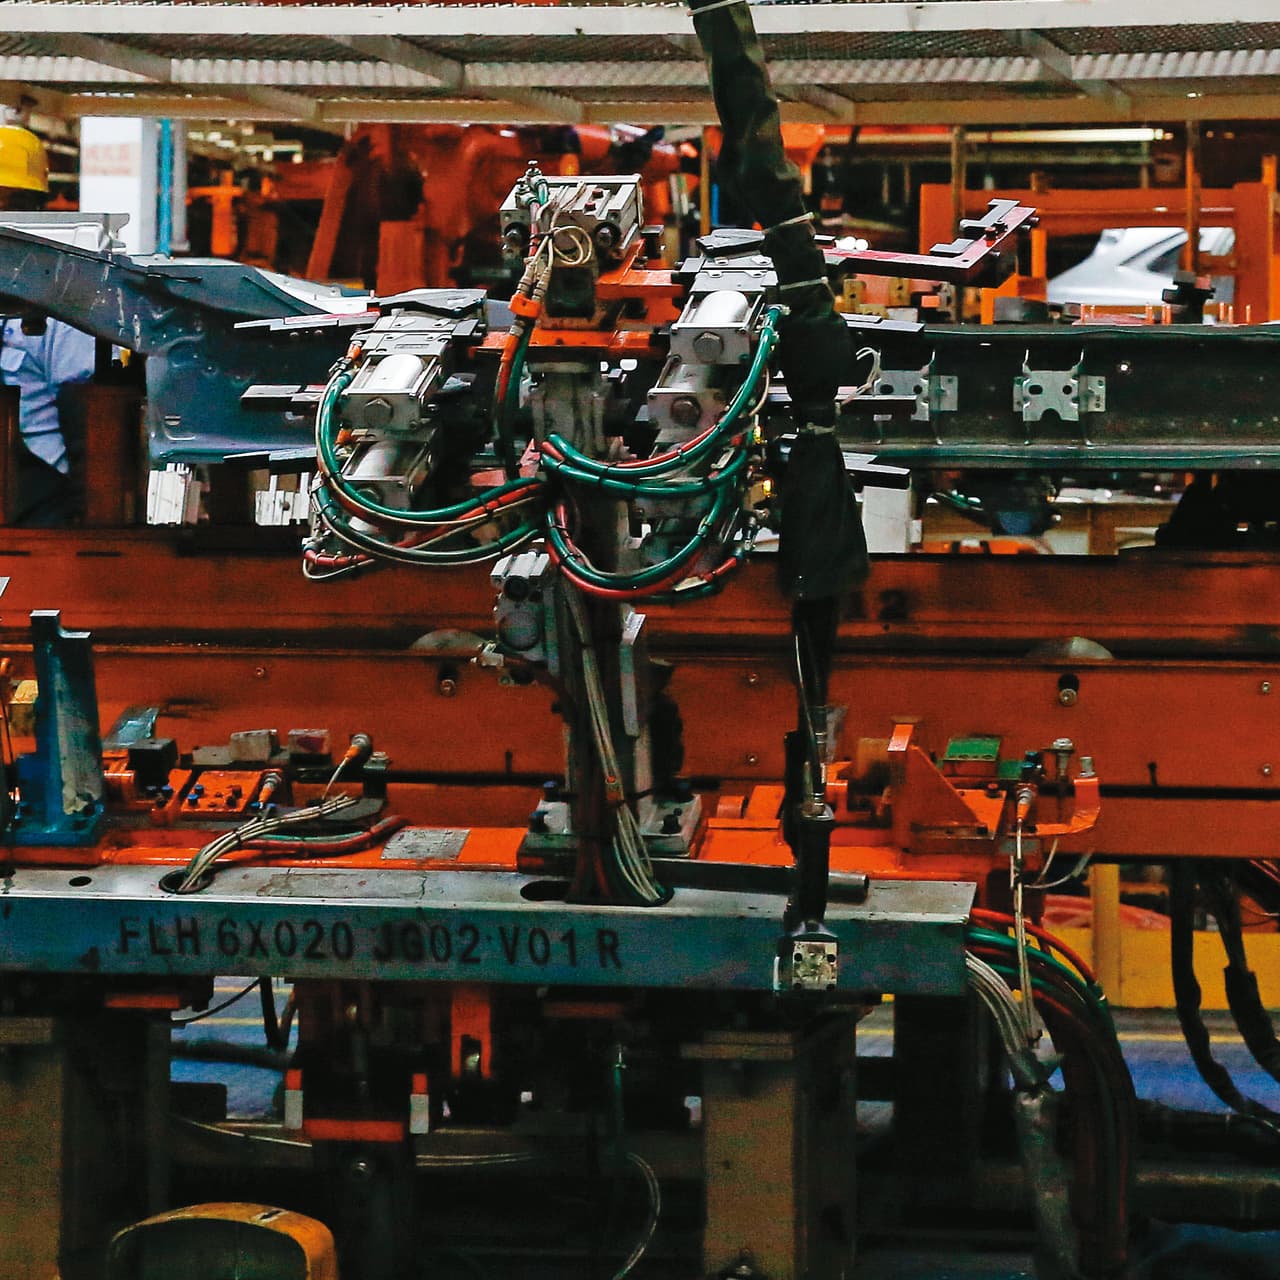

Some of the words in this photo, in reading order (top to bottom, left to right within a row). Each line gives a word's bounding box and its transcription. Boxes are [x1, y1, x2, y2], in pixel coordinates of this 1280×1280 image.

[119, 916, 201, 956] FLH
[217, 917, 355, 960] 6X020
[596, 927, 624, 969] R
